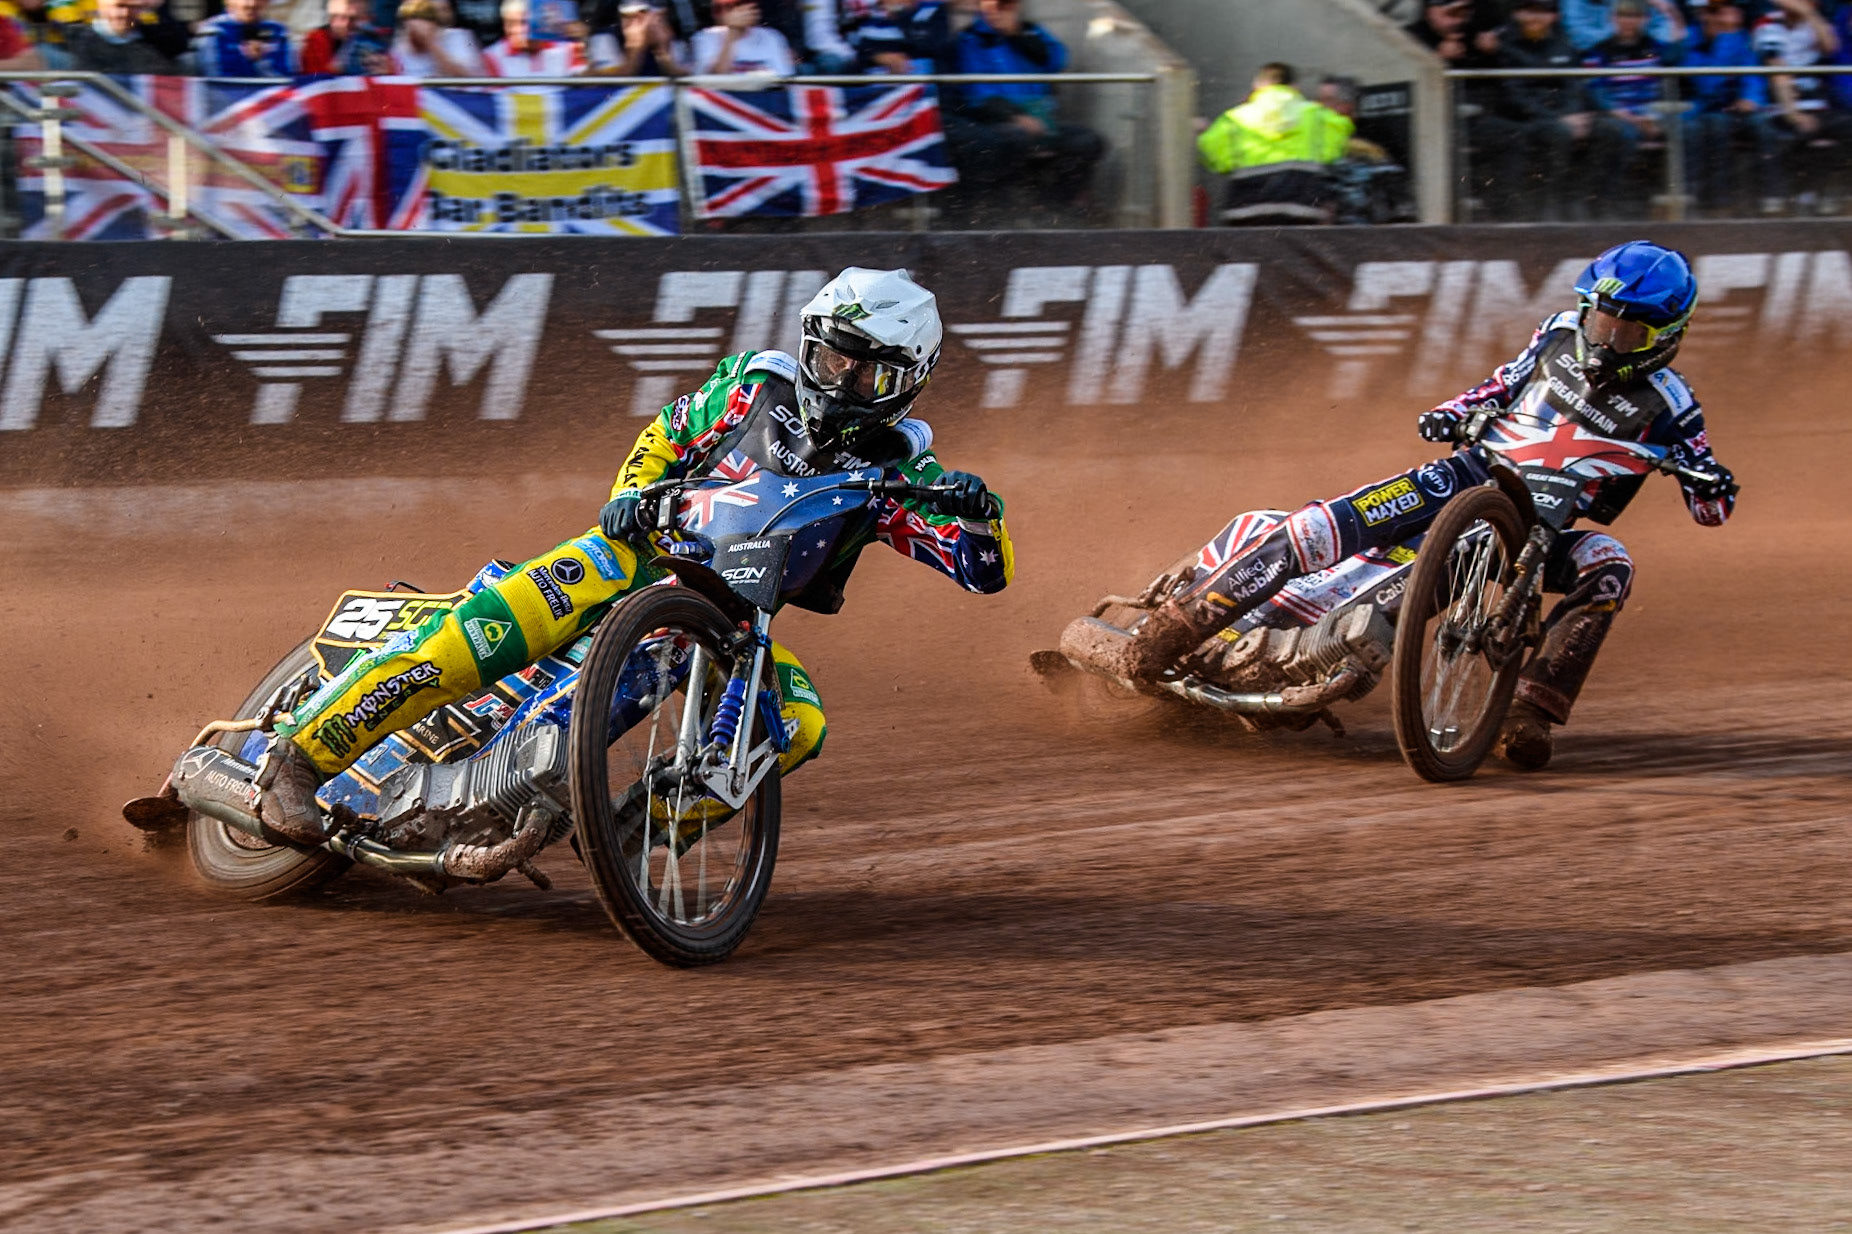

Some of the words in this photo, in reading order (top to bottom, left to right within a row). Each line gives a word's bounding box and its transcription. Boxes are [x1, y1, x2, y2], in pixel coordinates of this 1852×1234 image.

[209, 273, 555, 425] FIM
[952, 262, 1260, 408] FIM
[1555, 353, 1587, 381] SO
[1548, 375, 1581, 411] GREAT
[1574, 398, 1619, 434] BRITAIN
[768, 404, 810, 439] SO
[1361, 480, 1414, 511] POWER
[1366, 490, 1420, 523] MAXED
[1531, 492, 1563, 506] ON
[728, 540, 771, 553] AUSTRALIA
[527, 569, 549, 590] AUTO
[721, 566, 767, 581] SON
[1228, 557, 1266, 590] Allied
[1233, 556, 1289, 602] Mobility
[325, 598, 405, 640] 25
[465, 621, 487, 660] AUSTRALIA
[345, 662, 441, 728] MONSTER
[367, 680, 438, 730] ENERY
[414, 724, 439, 745] ARINE
[204, 770, 229, 788] AUTO
